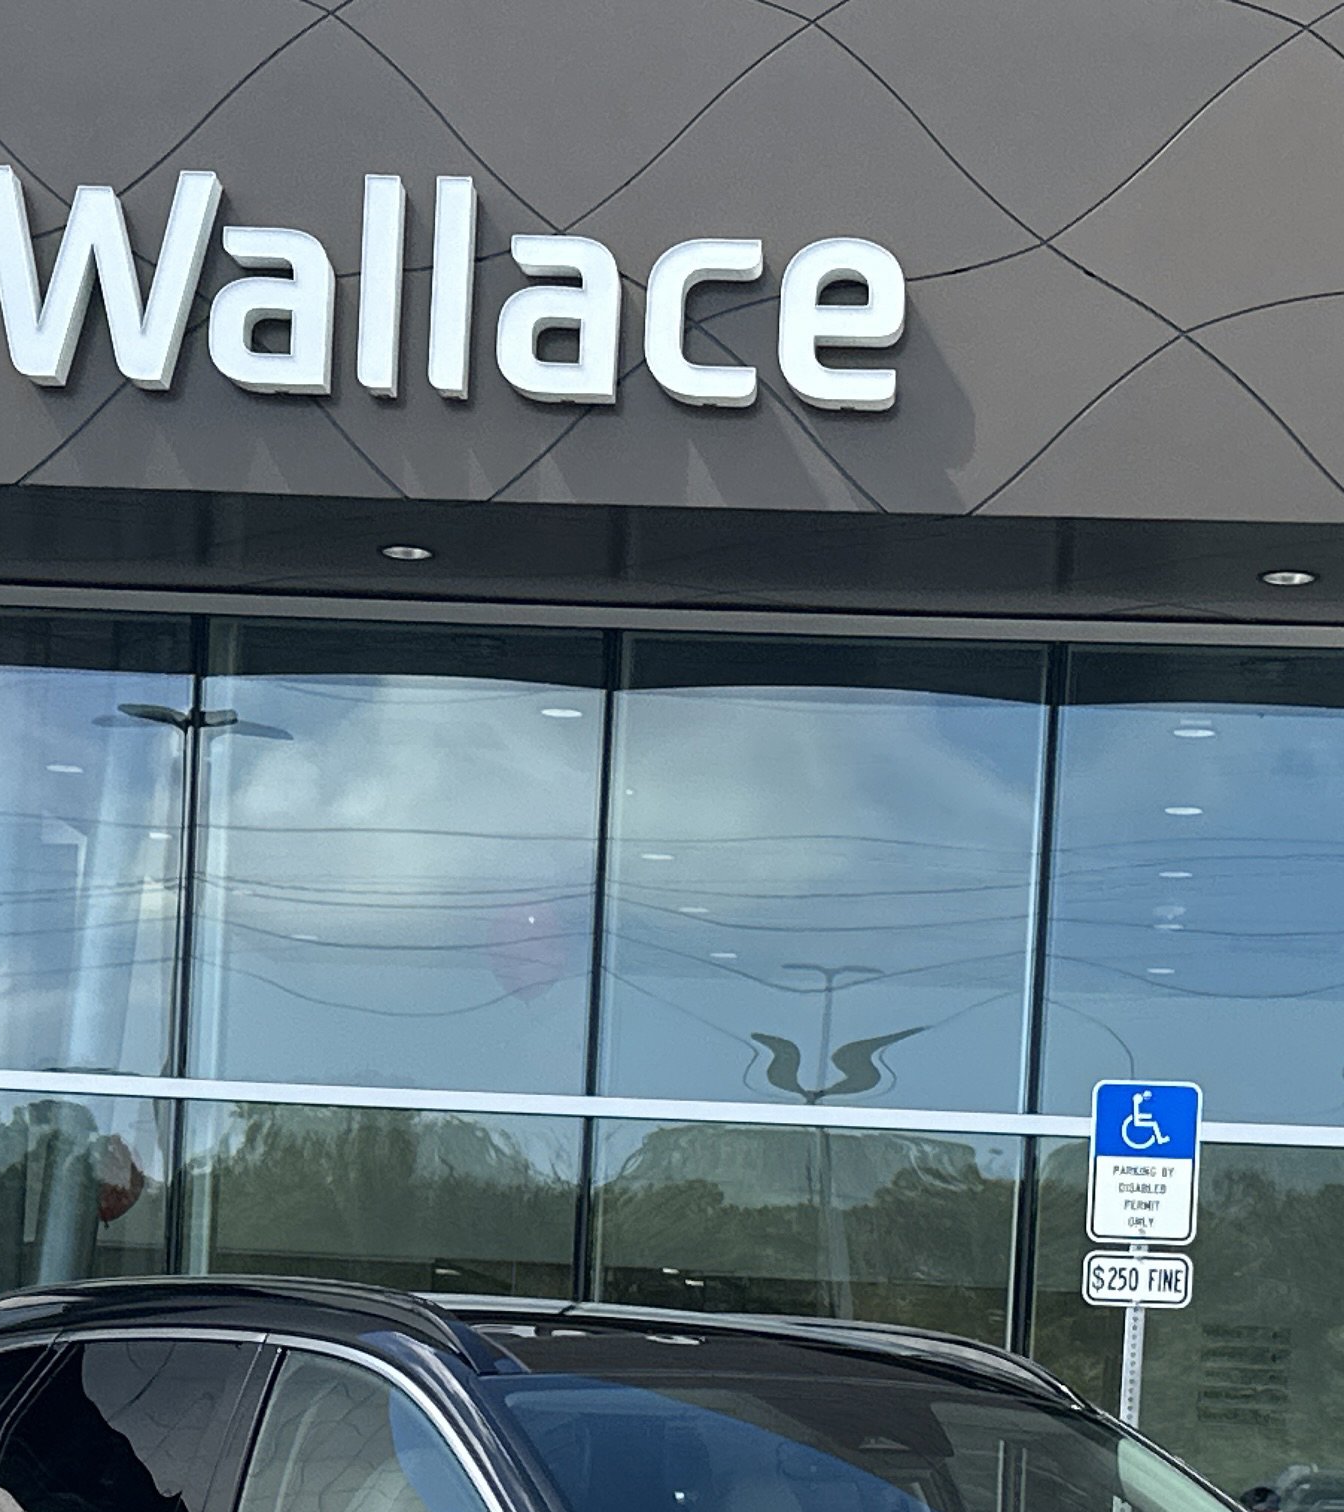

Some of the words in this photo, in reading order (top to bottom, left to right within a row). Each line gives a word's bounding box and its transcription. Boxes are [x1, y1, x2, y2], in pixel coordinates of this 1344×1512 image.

[1112, 1165, 1158, 1178] PARKING
[1161, 1166, 1175, 1178] BY
[1118, 1181, 1167, 1195] DISABLED
[1123, 1198, 1161, 1212] PERMIT
[1091, 1264, 1139, 1293] $250
[1148, 1267, 1184, 1294] FINE
